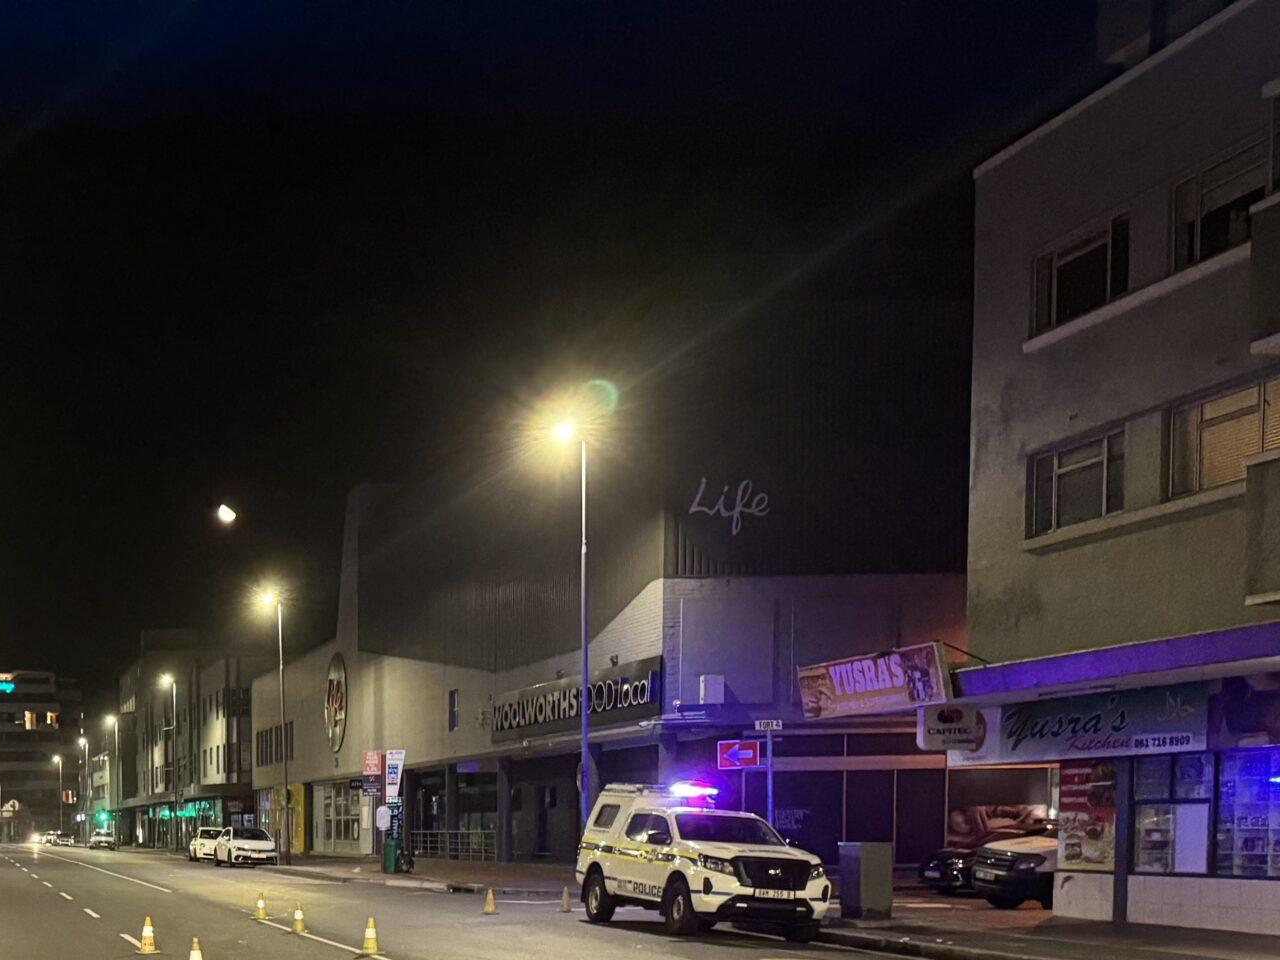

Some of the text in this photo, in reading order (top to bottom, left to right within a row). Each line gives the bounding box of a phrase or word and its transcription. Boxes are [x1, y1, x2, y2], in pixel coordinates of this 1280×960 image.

[688, 476, 770, 536] Life
[828, 654, 906, 697] YUSRA'S
[493, 687, 577, 731] WOOLWORTHS
[1004, 695, 1128, 751] Yusra's
[633, 881, 663, 898] POLICE
